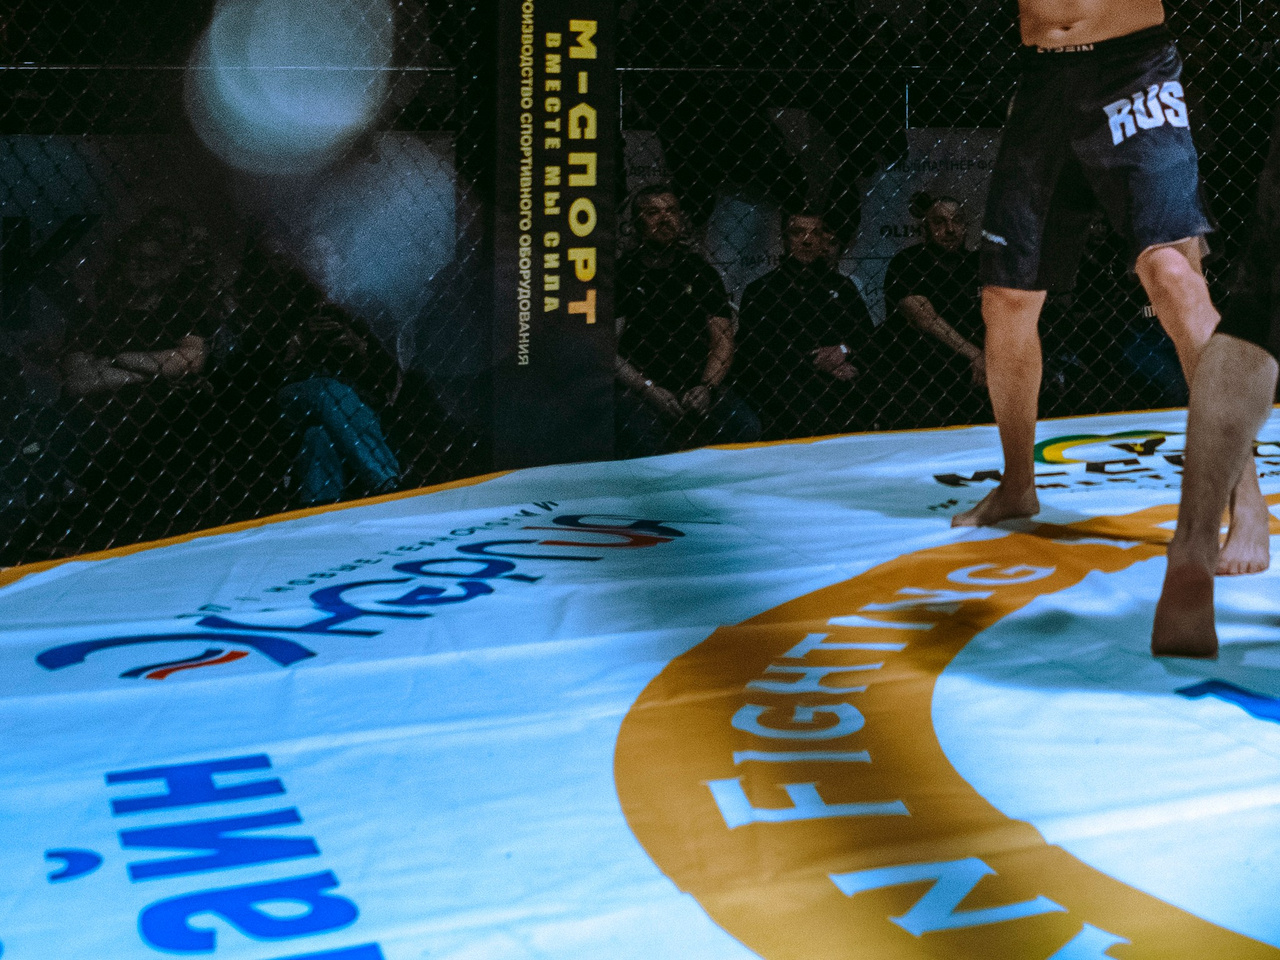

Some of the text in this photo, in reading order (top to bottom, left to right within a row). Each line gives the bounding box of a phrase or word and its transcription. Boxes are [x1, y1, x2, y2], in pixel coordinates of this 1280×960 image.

[518, 111, 534, 232] СПОРТИВНОГО
[542, 31, 563, 313] ВМЕСТЕ МЫ СИЛА
[567, 18, 599, 325] М-СПОРТ
[516, 233, 533, 366] ОБОРУДОВАНИЯ
[705, 562, 1057, 831] FIGHTING
[44, 752, 386, 960] айн
